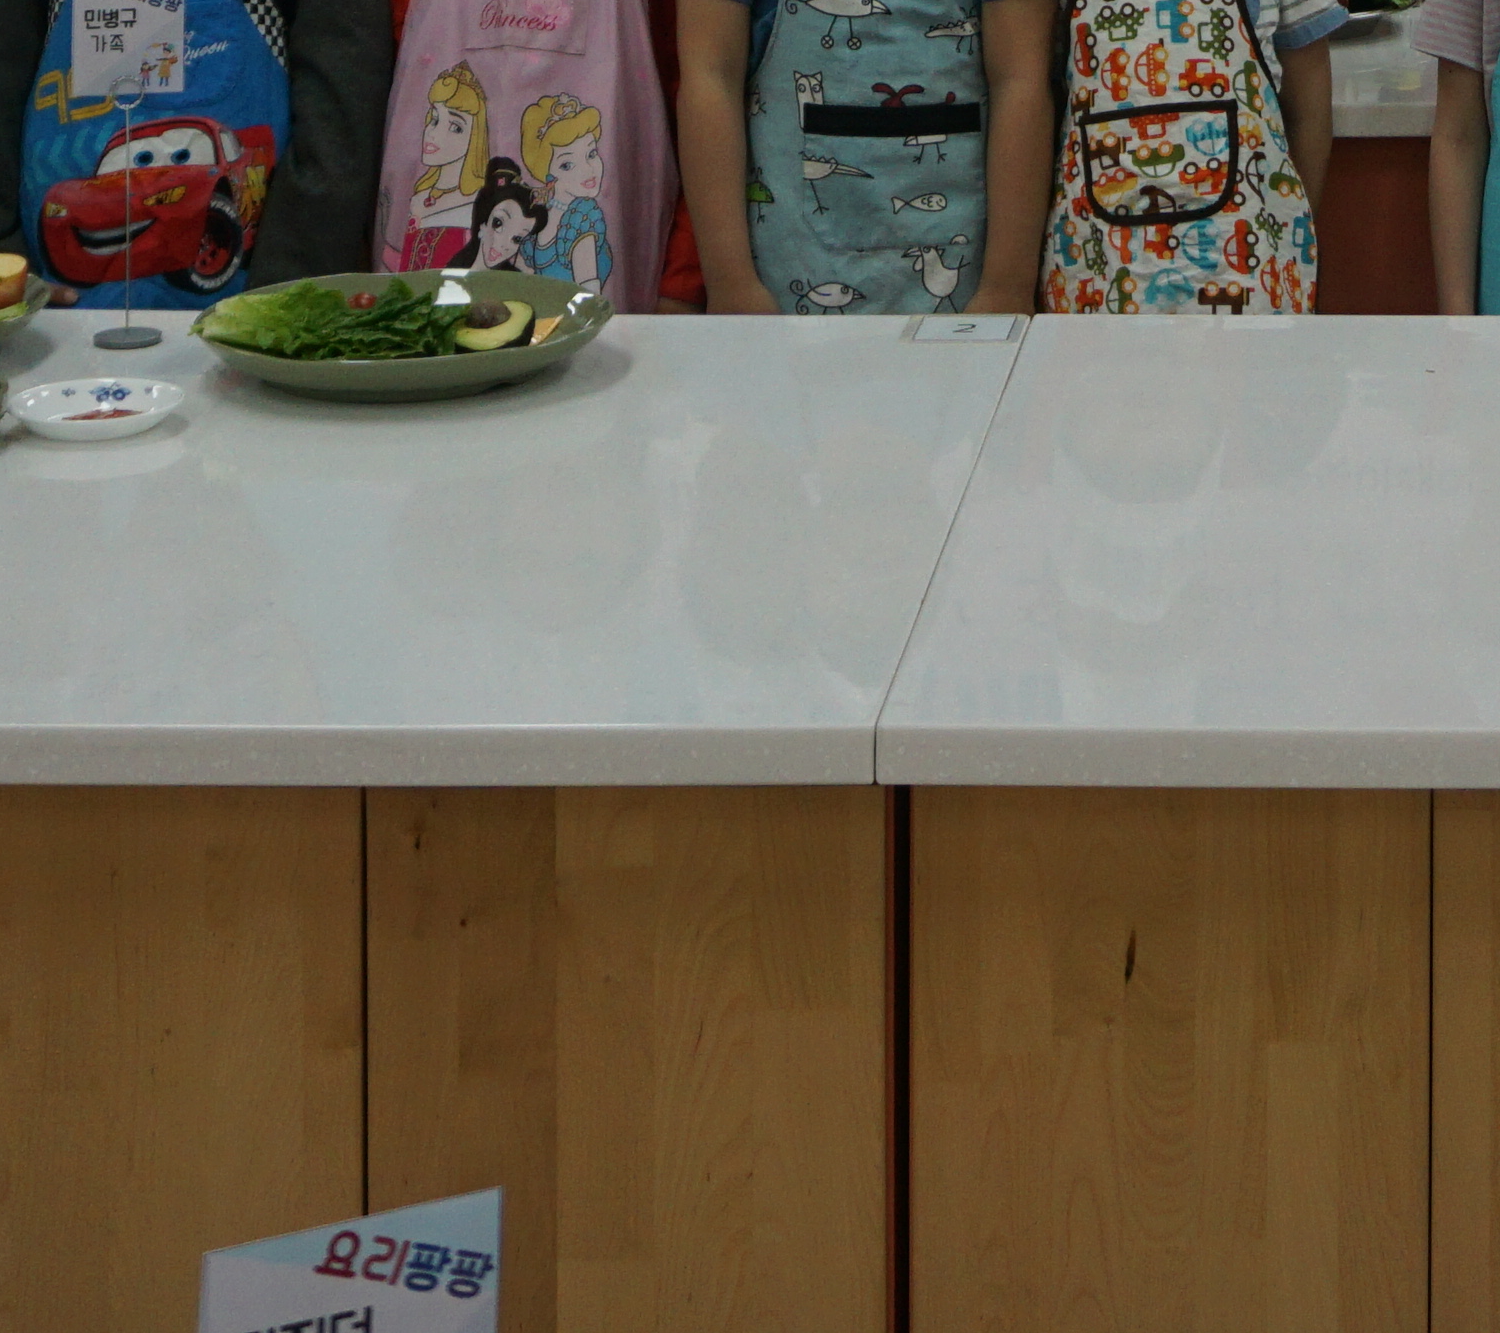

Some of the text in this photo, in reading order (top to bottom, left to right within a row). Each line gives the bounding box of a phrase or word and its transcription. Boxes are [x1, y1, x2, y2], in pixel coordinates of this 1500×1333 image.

[83, 7, 137, 31] 민병규
[90, 32, 125, 54] 가족
[312, 1229, 496, 1300] 요리팡팡
